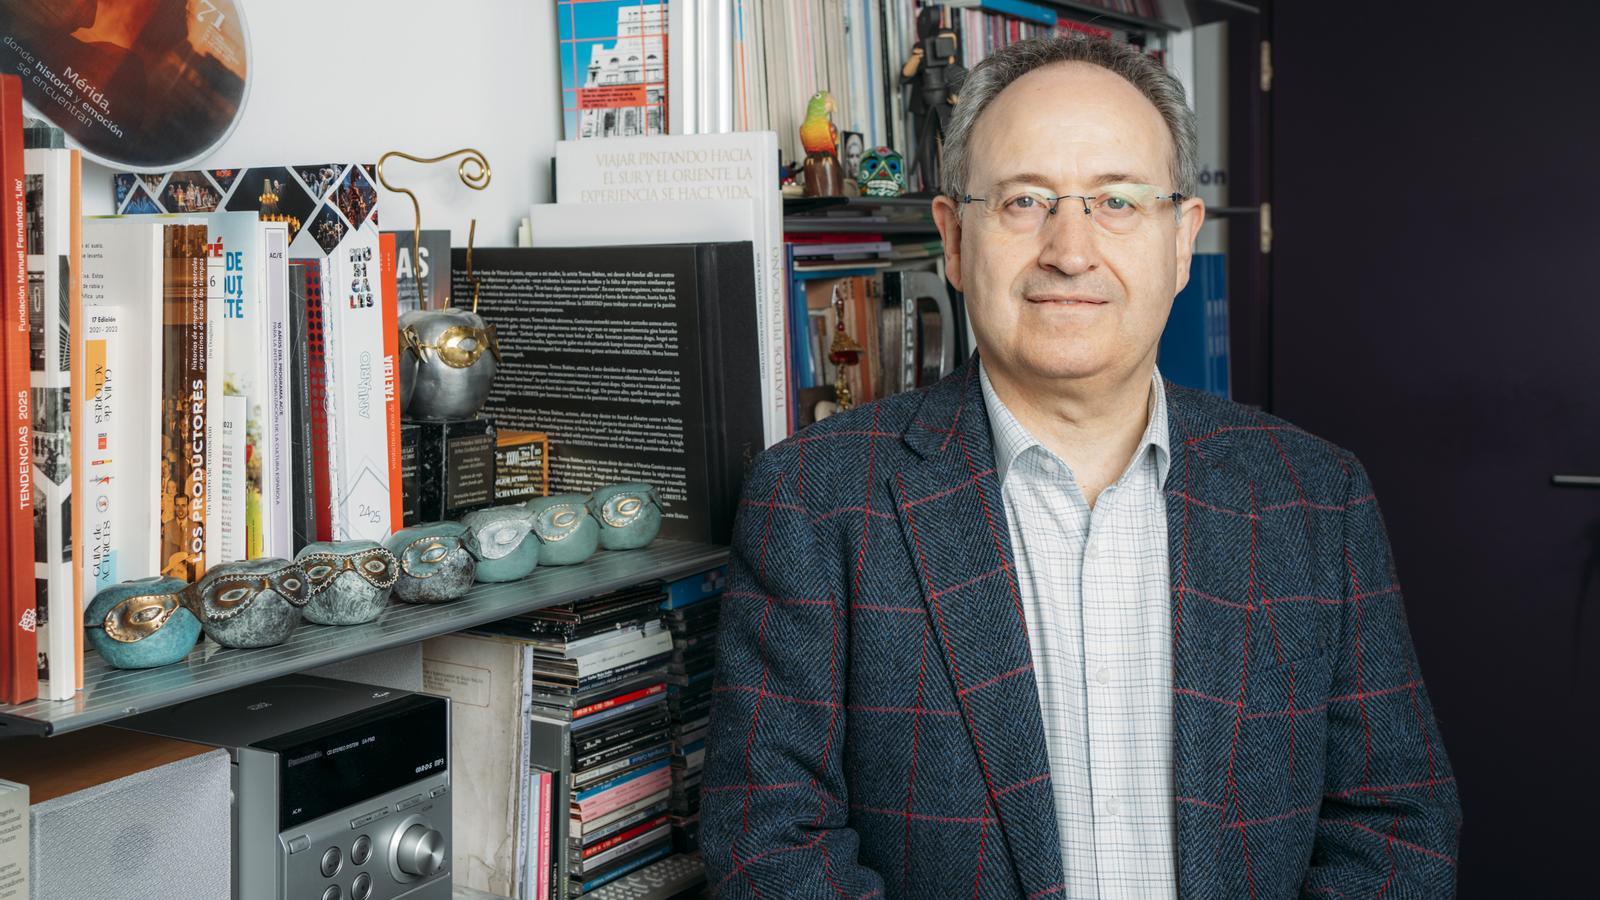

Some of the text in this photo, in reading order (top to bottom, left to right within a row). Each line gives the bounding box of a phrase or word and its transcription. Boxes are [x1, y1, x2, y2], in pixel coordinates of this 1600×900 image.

[3, 35, 124, 139] donde historia y emoción
[16, 62, 94, 129] se encuentran
[63, 66, 112, 115] Mérida,
[596, 148, 752, 168] VIAJAR PINTANDO HACIA
[604, 172, 614, 184] EL
[618, 170, 642, 184] SUR
[642, 170, 653, 184] Y
[656, 170, 669, 182] EL
[736, 166, 752, 180] LA
[580, 188, 659, 204] EXPERIENCIA
[662, 188, 674, 202] SE
[678, 186, 714, 202] HACE
[16, 200, 25, 250] Fernández
[17, 250, 26, 288] Manuel
[226, 252, 243, 270] DE
[210, 275, 216, 287] 6
[18, 292, 26, 332] Fundación
[349, 294, 374, 309] LES
[98, 315, 116, 323] Edición
[198, 322, 204, 330] de
[192, 331, 198, 340] de
[358, 351, 373, 419] ANUARIO
[774, 344, 784, 412] TEATROS
[94, 364, 104, 424] ACTORES
[104, 405, 112, 422] de
[18, 390, 30, 510] TENDENCIAS 2025
[192, 379, 203, 562] LOS PRODUCTORES
[92, 524, 102, 540] de
[102, 520, 112, 582] ACTRICES
[288, 750, 323, 768] Panasonic
